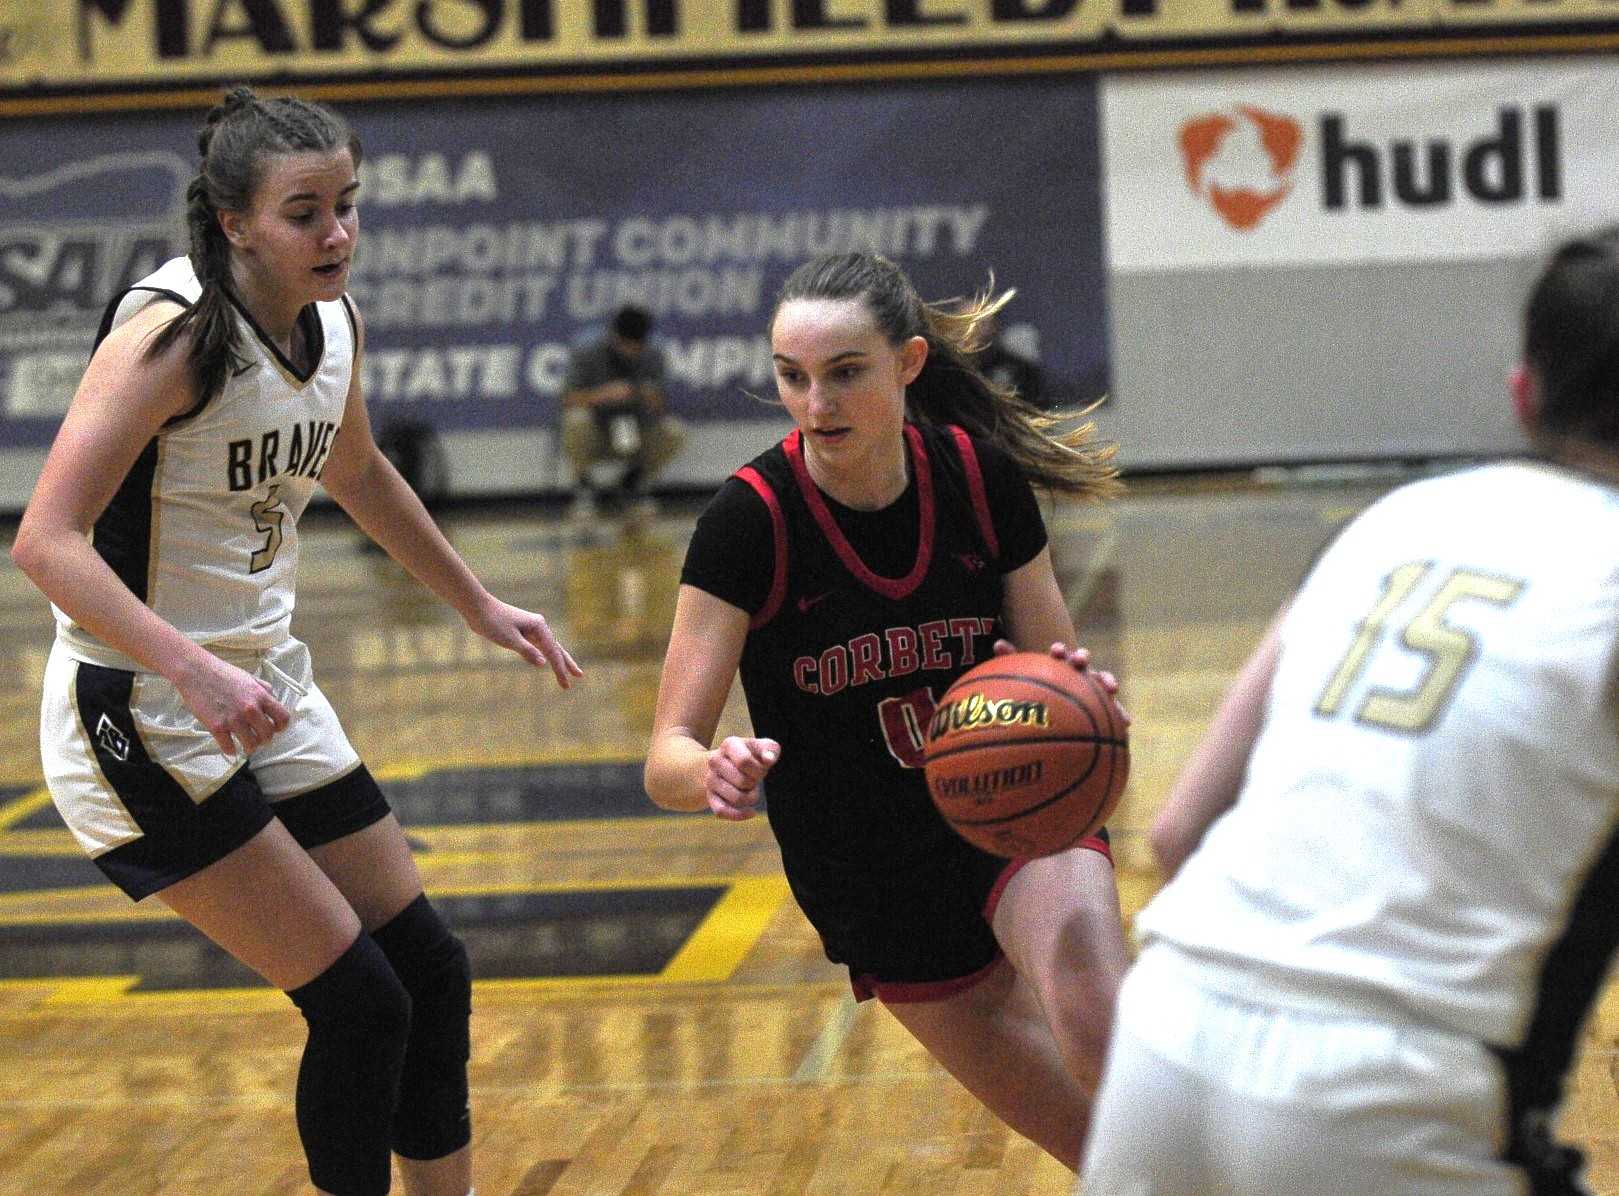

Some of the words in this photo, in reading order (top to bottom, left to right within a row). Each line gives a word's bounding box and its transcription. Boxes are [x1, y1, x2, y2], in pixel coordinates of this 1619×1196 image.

[1320, 105, 1562, 212] hudl
[612, 203, 989, 266] COMMUNITY
[566, 266, 764, 322] UNION
[227, 420, 340, 492] BRAVE
[249, 483, 285, 575] 5
[1310, 557, 1530, 740] 15
